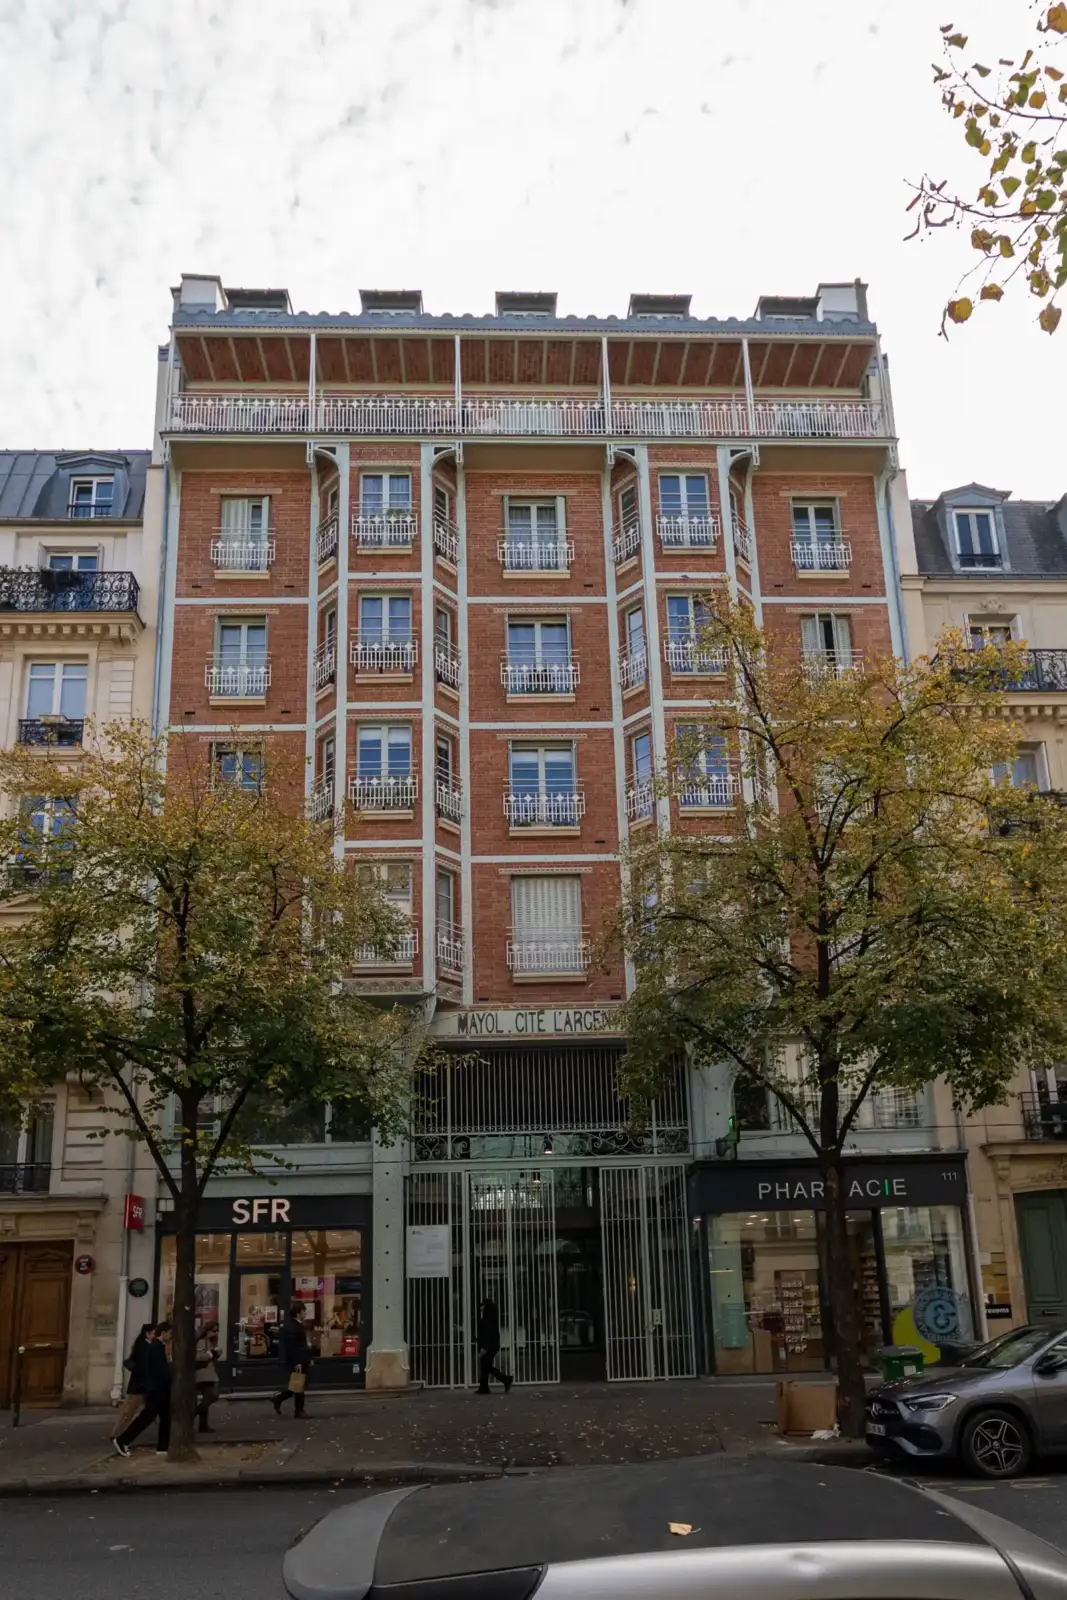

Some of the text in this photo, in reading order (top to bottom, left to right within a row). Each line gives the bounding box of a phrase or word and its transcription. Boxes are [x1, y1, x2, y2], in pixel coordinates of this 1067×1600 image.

[941, 1172, 958, 1181] 111
[757, 1178, 907, 1200] PHARACIE
[132, 1204, 145, 1219] SFR
[231, 1198, 291, 1225] SFR
